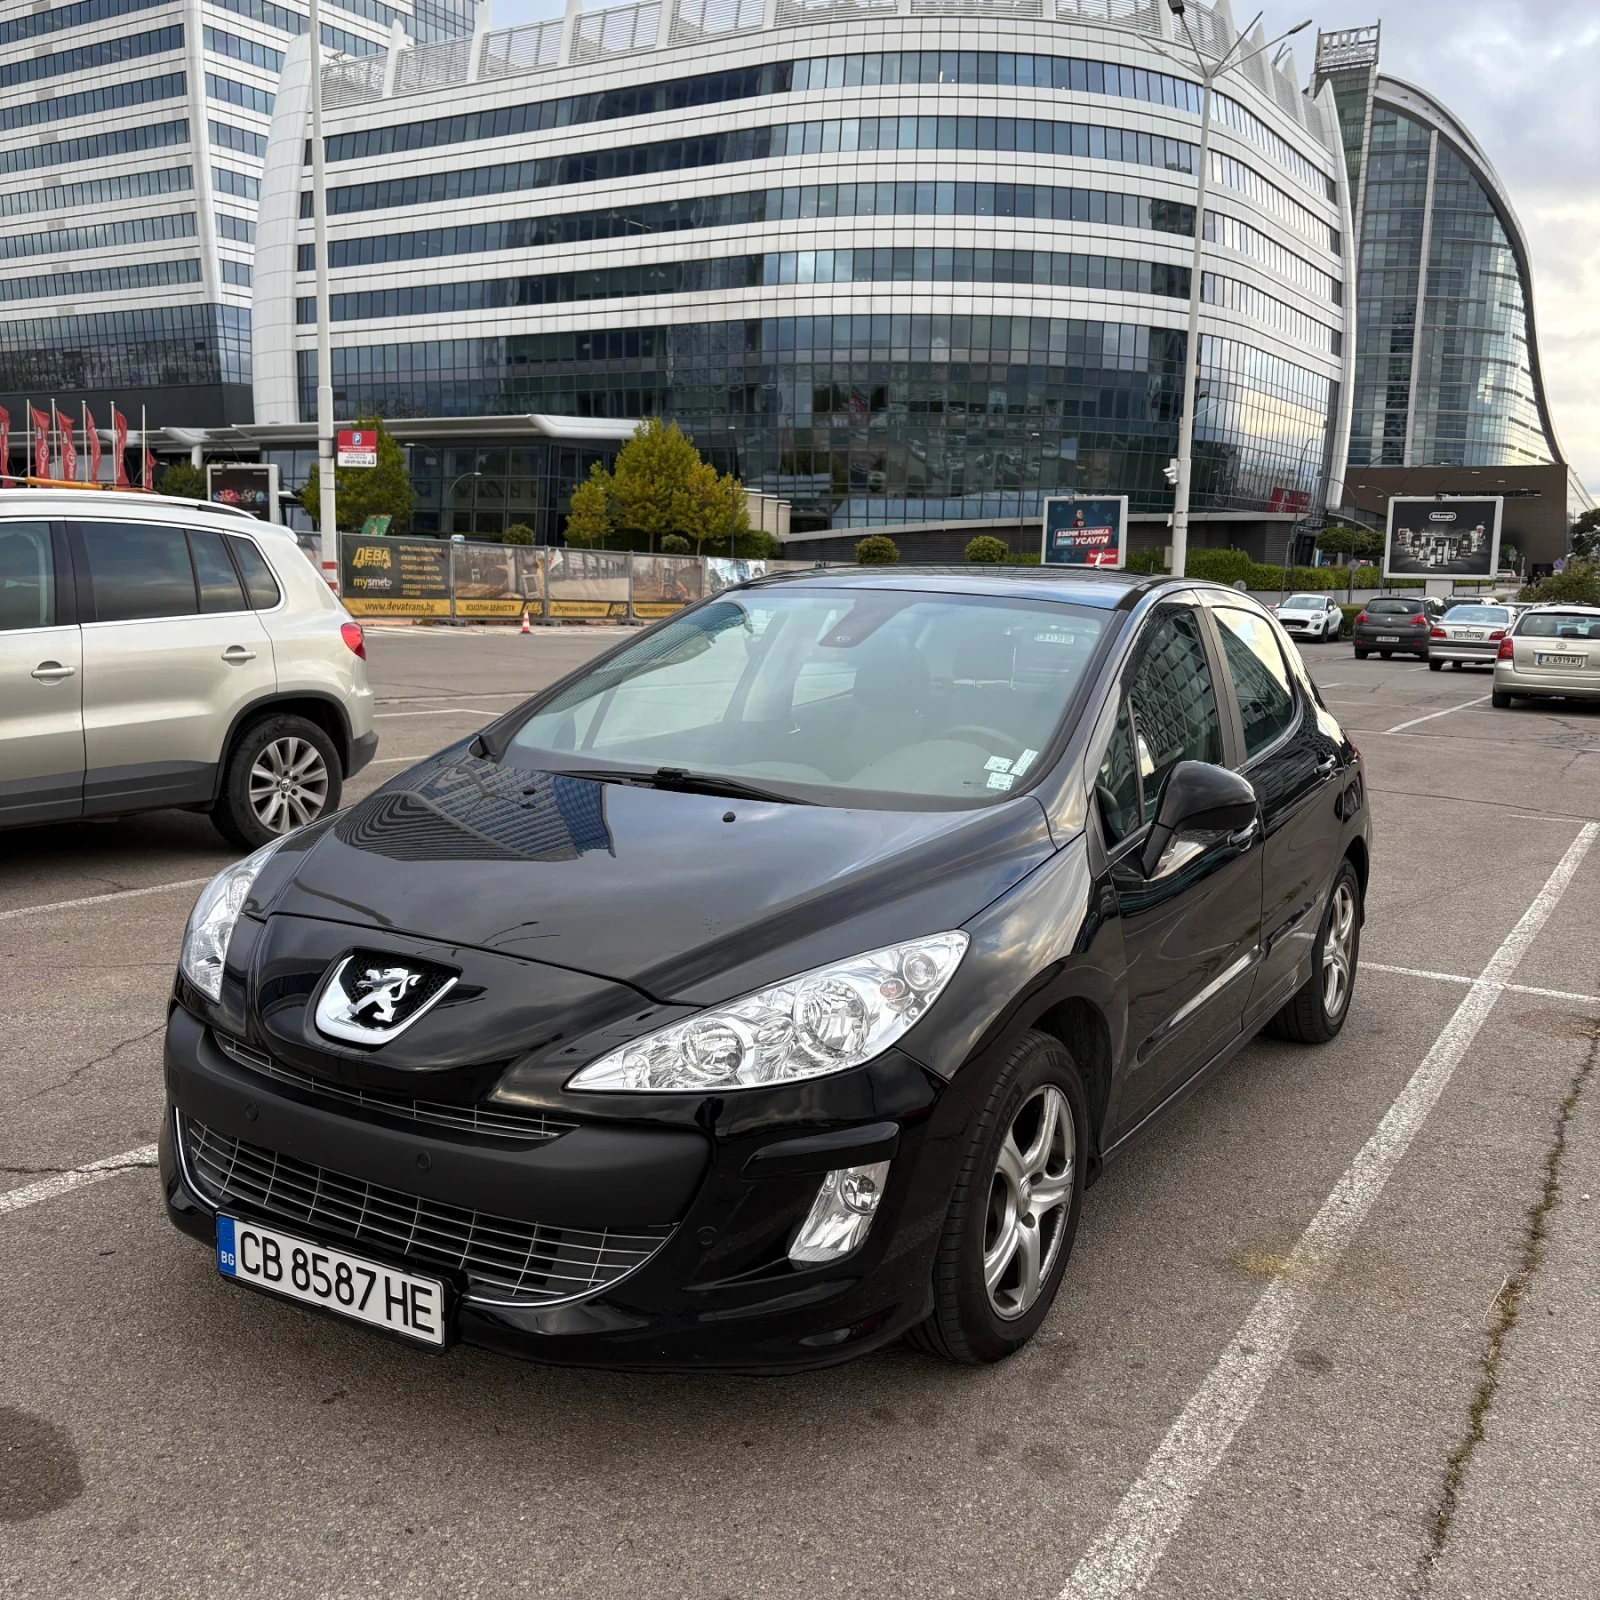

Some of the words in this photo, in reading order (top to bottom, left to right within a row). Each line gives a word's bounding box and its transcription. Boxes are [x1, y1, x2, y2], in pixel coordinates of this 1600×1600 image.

[1080, 528, 1109, 536] ТЕХНИКА
[1075, 536, 1109, 545] УСЛУГИ
[354, 547, 390, 562] ДЕВА
[365, 602, 435, 612] www.devatrans.bg
[221, 1251, 235, 1266] BG
[240, 1231, 283, 1282] CB
[291, 1248, 377, 1311] 8587
[384, 1275, 435, 1334] HE
